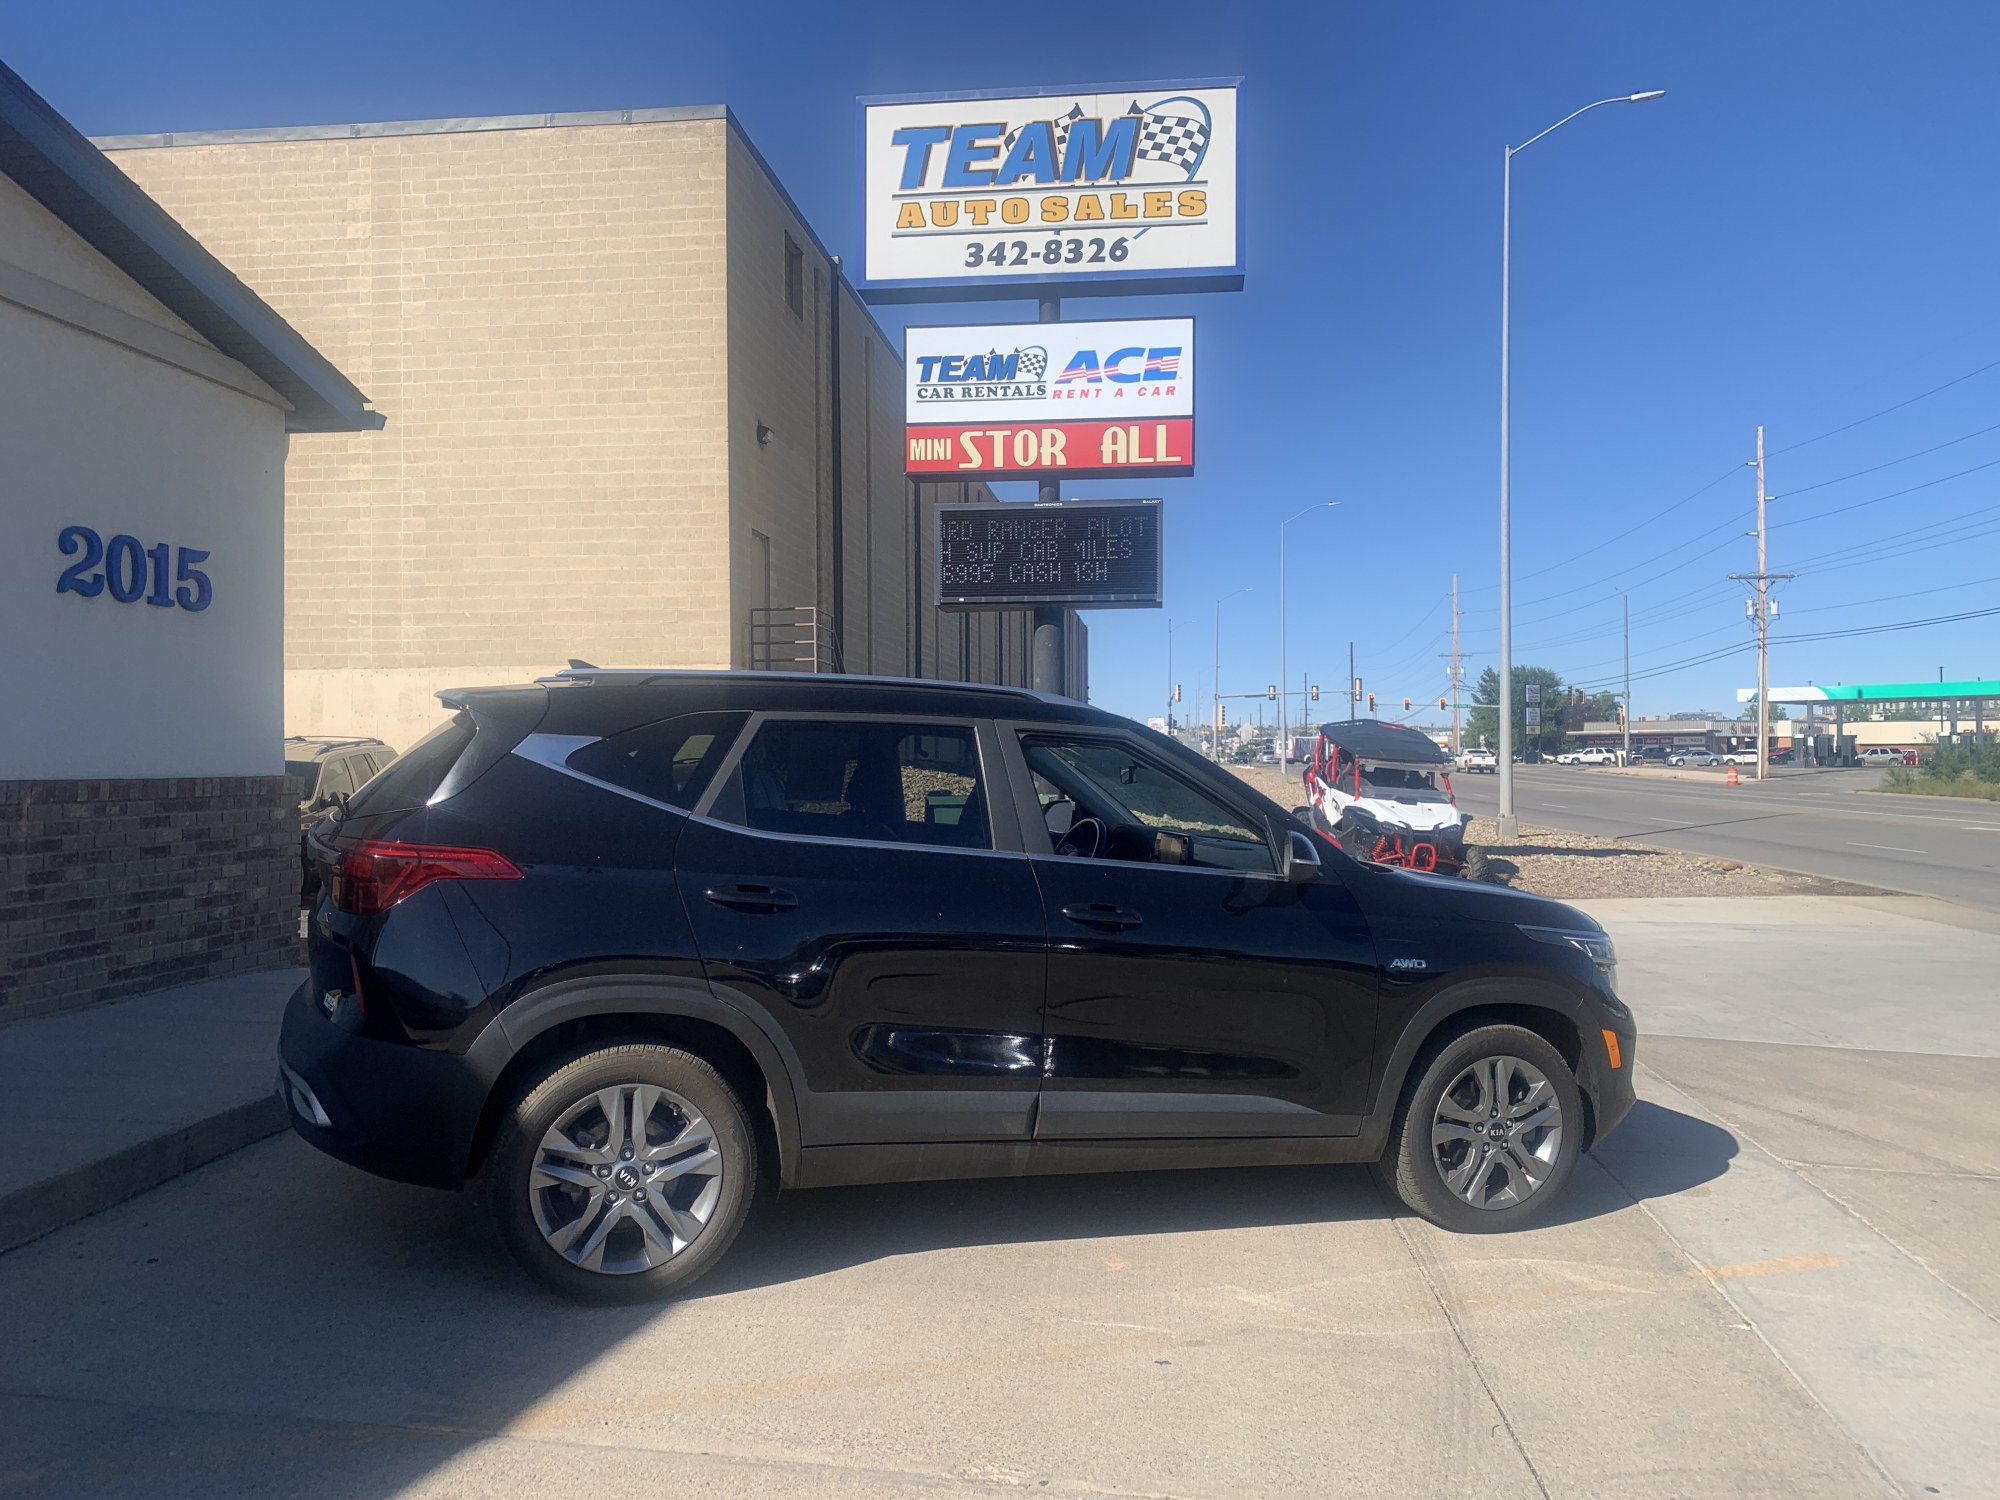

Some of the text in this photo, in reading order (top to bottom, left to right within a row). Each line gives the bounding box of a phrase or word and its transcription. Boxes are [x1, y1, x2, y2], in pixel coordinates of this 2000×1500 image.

[891, 114, 1144, 191] TEAM
[895, 189, 1208, 229] AUTO SALES
[964, 236, 1130, 268] 342-8326
[916, 352, 1021, 383] TEAM
[1054, 346, 1183, 384] ACE
[916, 384, 1047, 400] CAR RENTALS
[1052, 385, 1177, 400] RENT A CAR
[909, 424, 1183, 470] MINI STOR ALL
[987, 518, 1067, 540] RANGER
[1087, 516, 1149, 538] PILOT
[966, 541, 1005, 562] SUP
[1020, 540, 1059, 561] CAB
[56, 525, 213, 612] 2015
[1009, 562, 1062, 583] CASH
[1390, 958, 1427, 969] AWD
[619, 1169, 637, 1188] KIA
